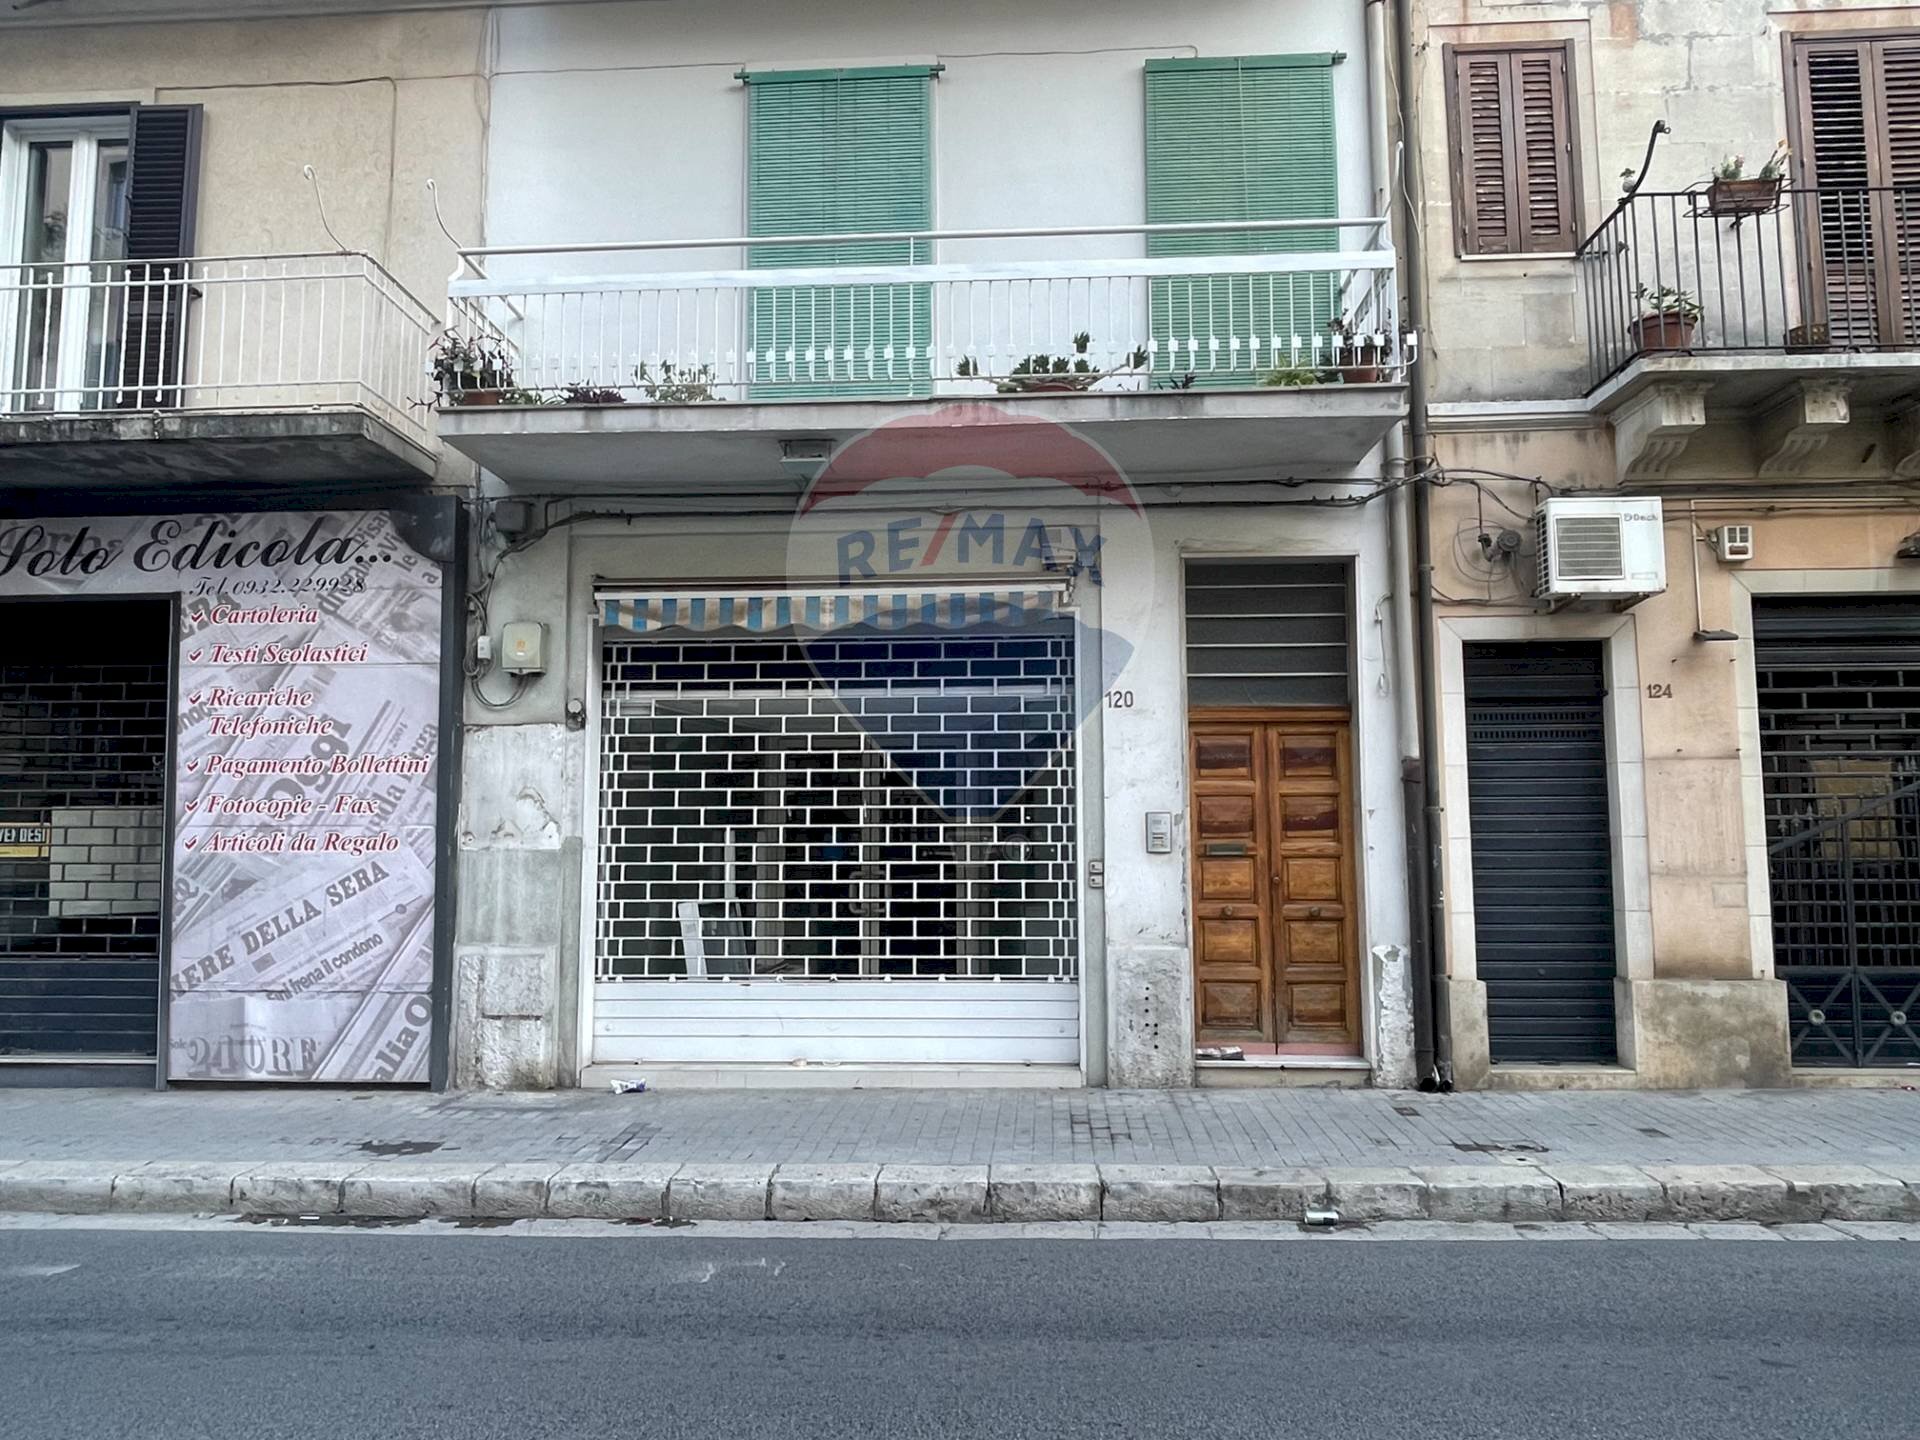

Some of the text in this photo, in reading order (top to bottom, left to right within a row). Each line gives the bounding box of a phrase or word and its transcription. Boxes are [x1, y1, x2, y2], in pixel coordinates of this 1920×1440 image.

[210, 604, 319, 625] Cartoleria
[210, 642, 369, 663] Testi Scolastici
[209, 688, 313, 707] Ricariche
[1104, 690, 1134, 709] 120
[1646, 683, 1673, 699] 124
[209, 716, 333, 738] Telefoniche
[206, 753, 430, 779] Pagamento Bollettini
[207, 794, 312, 819] Fotocopie
[334, 794, 378, 814] Fax
[204, 831, 400, 857] Articoli da Regalo
[170, 860, 390, 1000] IERE DELLA SERA
[331, 930, 384, 969] condono
